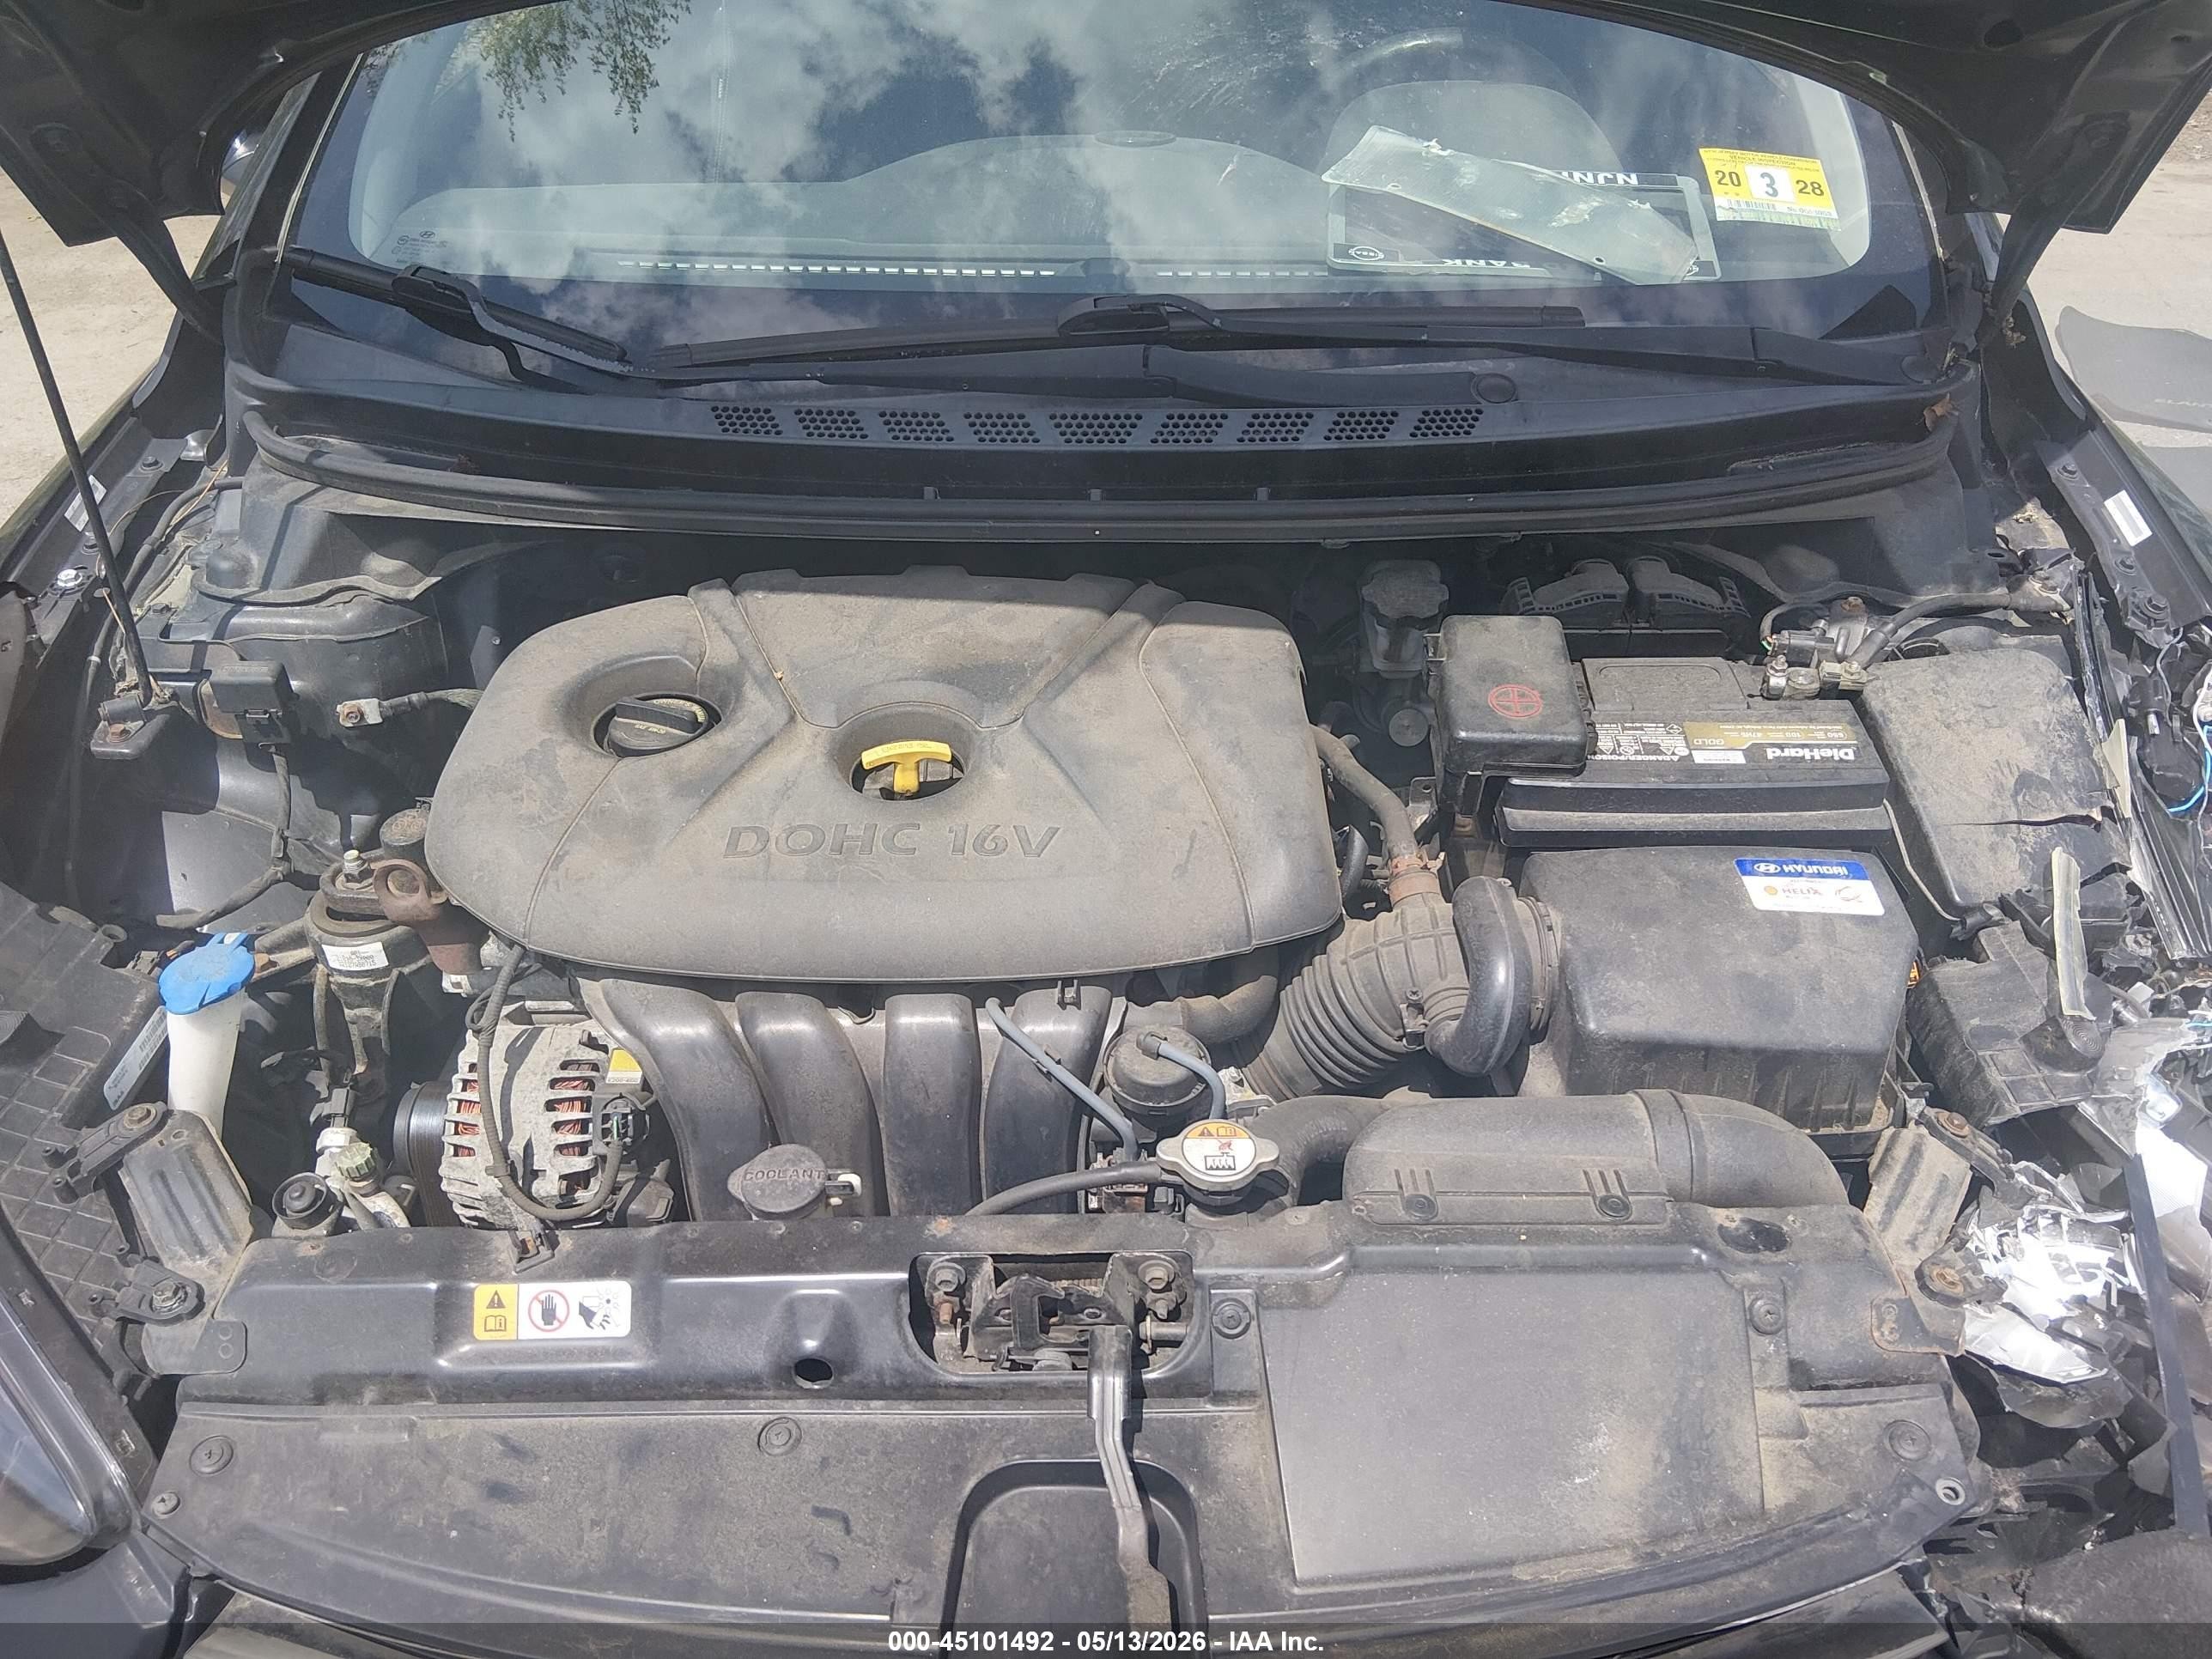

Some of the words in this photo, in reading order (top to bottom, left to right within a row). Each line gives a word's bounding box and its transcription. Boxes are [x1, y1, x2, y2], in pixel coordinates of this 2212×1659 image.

[1714, 169, 1742, 187] 20
[1759, 172, 1779, 198] 3
[1796, 179, 1825, 197] 28
[1693, 738, 1725, 746] GOLD
[1766, 746, 1856, 762] DieHard
[723, 823, 921, 859] DOHC
[947, 823, 1061, 858] 16V
[1782, 864, 1849, 877] HYUNDAI
[744, 1169, 826, 1182] COOLANT
